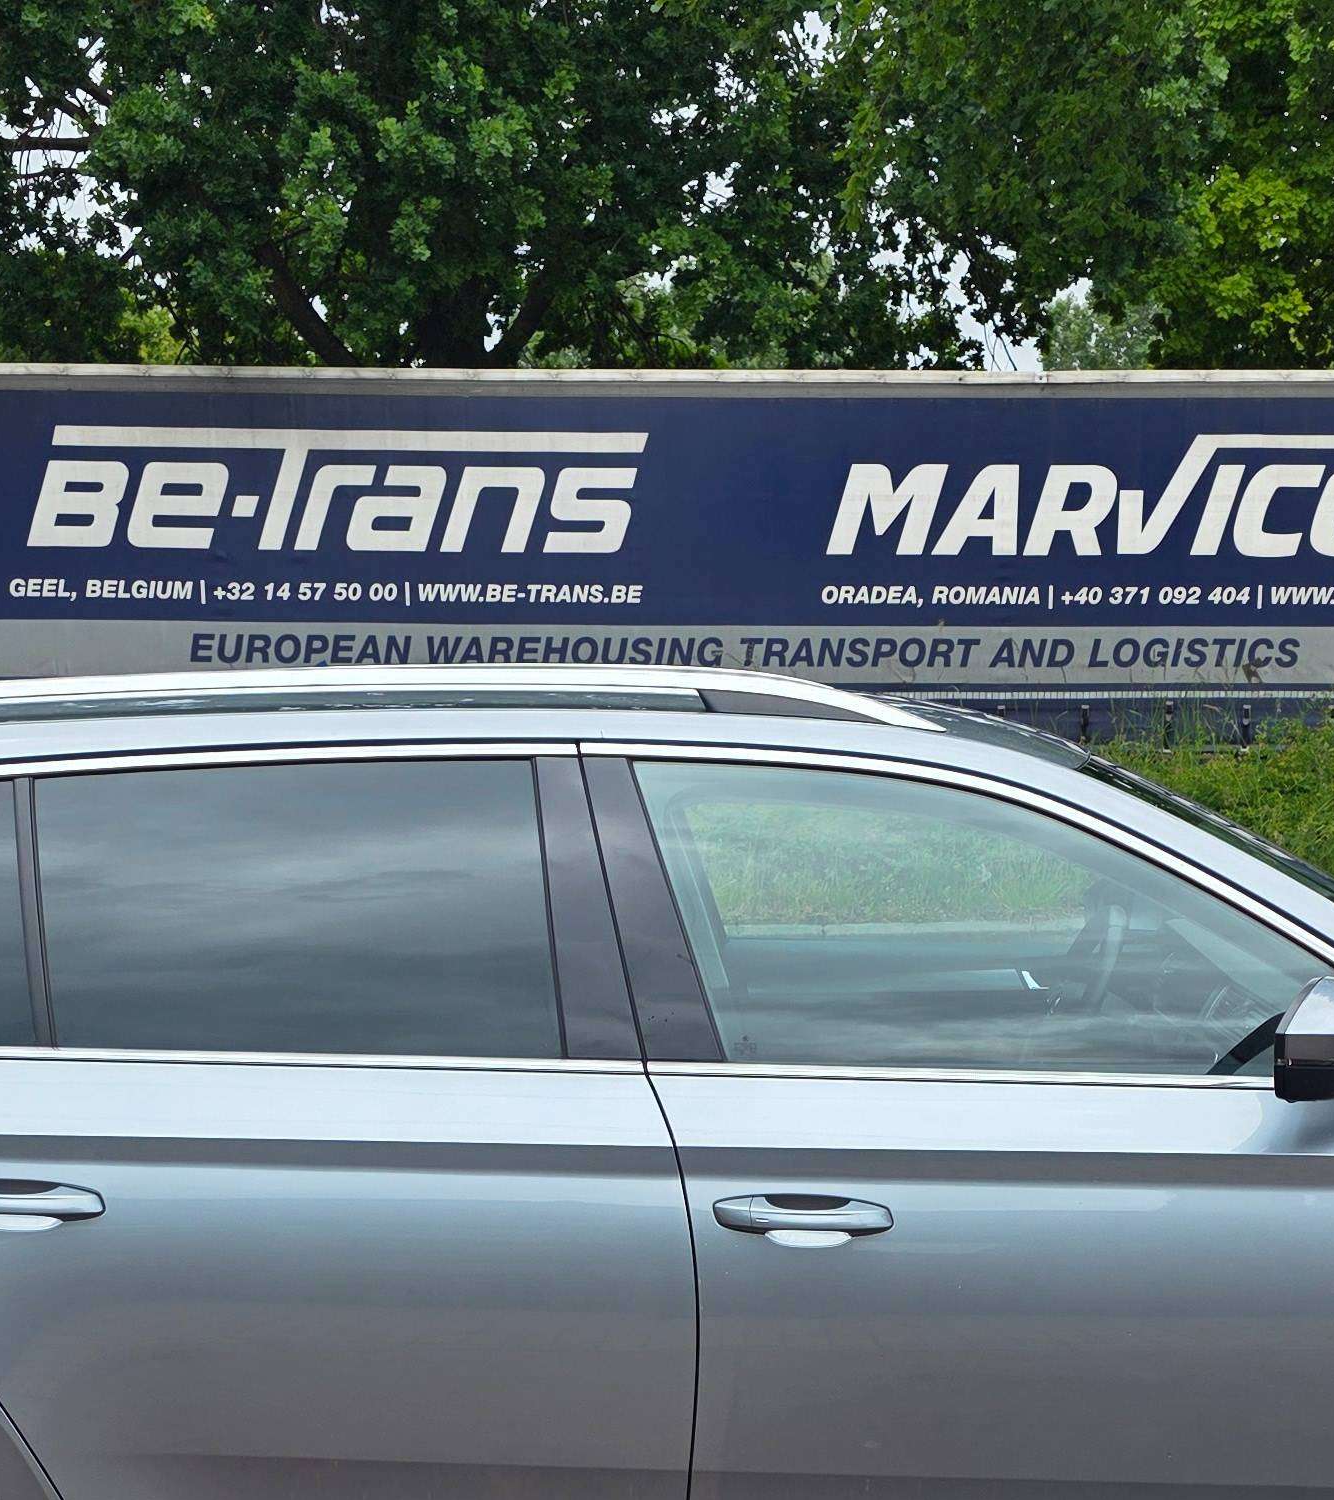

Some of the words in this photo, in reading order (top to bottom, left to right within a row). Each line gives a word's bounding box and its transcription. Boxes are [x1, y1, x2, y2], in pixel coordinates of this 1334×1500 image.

[9, 578, 77, 602] GEEL,
[85, 579, 194, 600] BELGIUM
[213, 581, 256, 601] +32
[264, 582, 291, 601] 14
[297, 582, 327, 601] 57
[333, 582, 362, 601] 50
[368, 582, 398, 602] 00
[417, 583, 644, 604] WWW.BE-TRANS.BE
[821, 585, 924, 609] ORADEA,
[931, 585, 1040, 605] ROMANIA
[1060, 586, 1103, 605] +40
[1108, 586, 1150, 605] 371
[1158, 586, 1202, 605] 092
[1207, 586, 1251, 605] 404
[190, 633, 412, 663] EUROPEAN
[426, 636, 724, 667] WAREHOUSING
[740, 637, 981, 668] TRANSPORT
[989, 638, 1075, 668] AND
[1088, 638, 1301, 668] LOGISTICS
